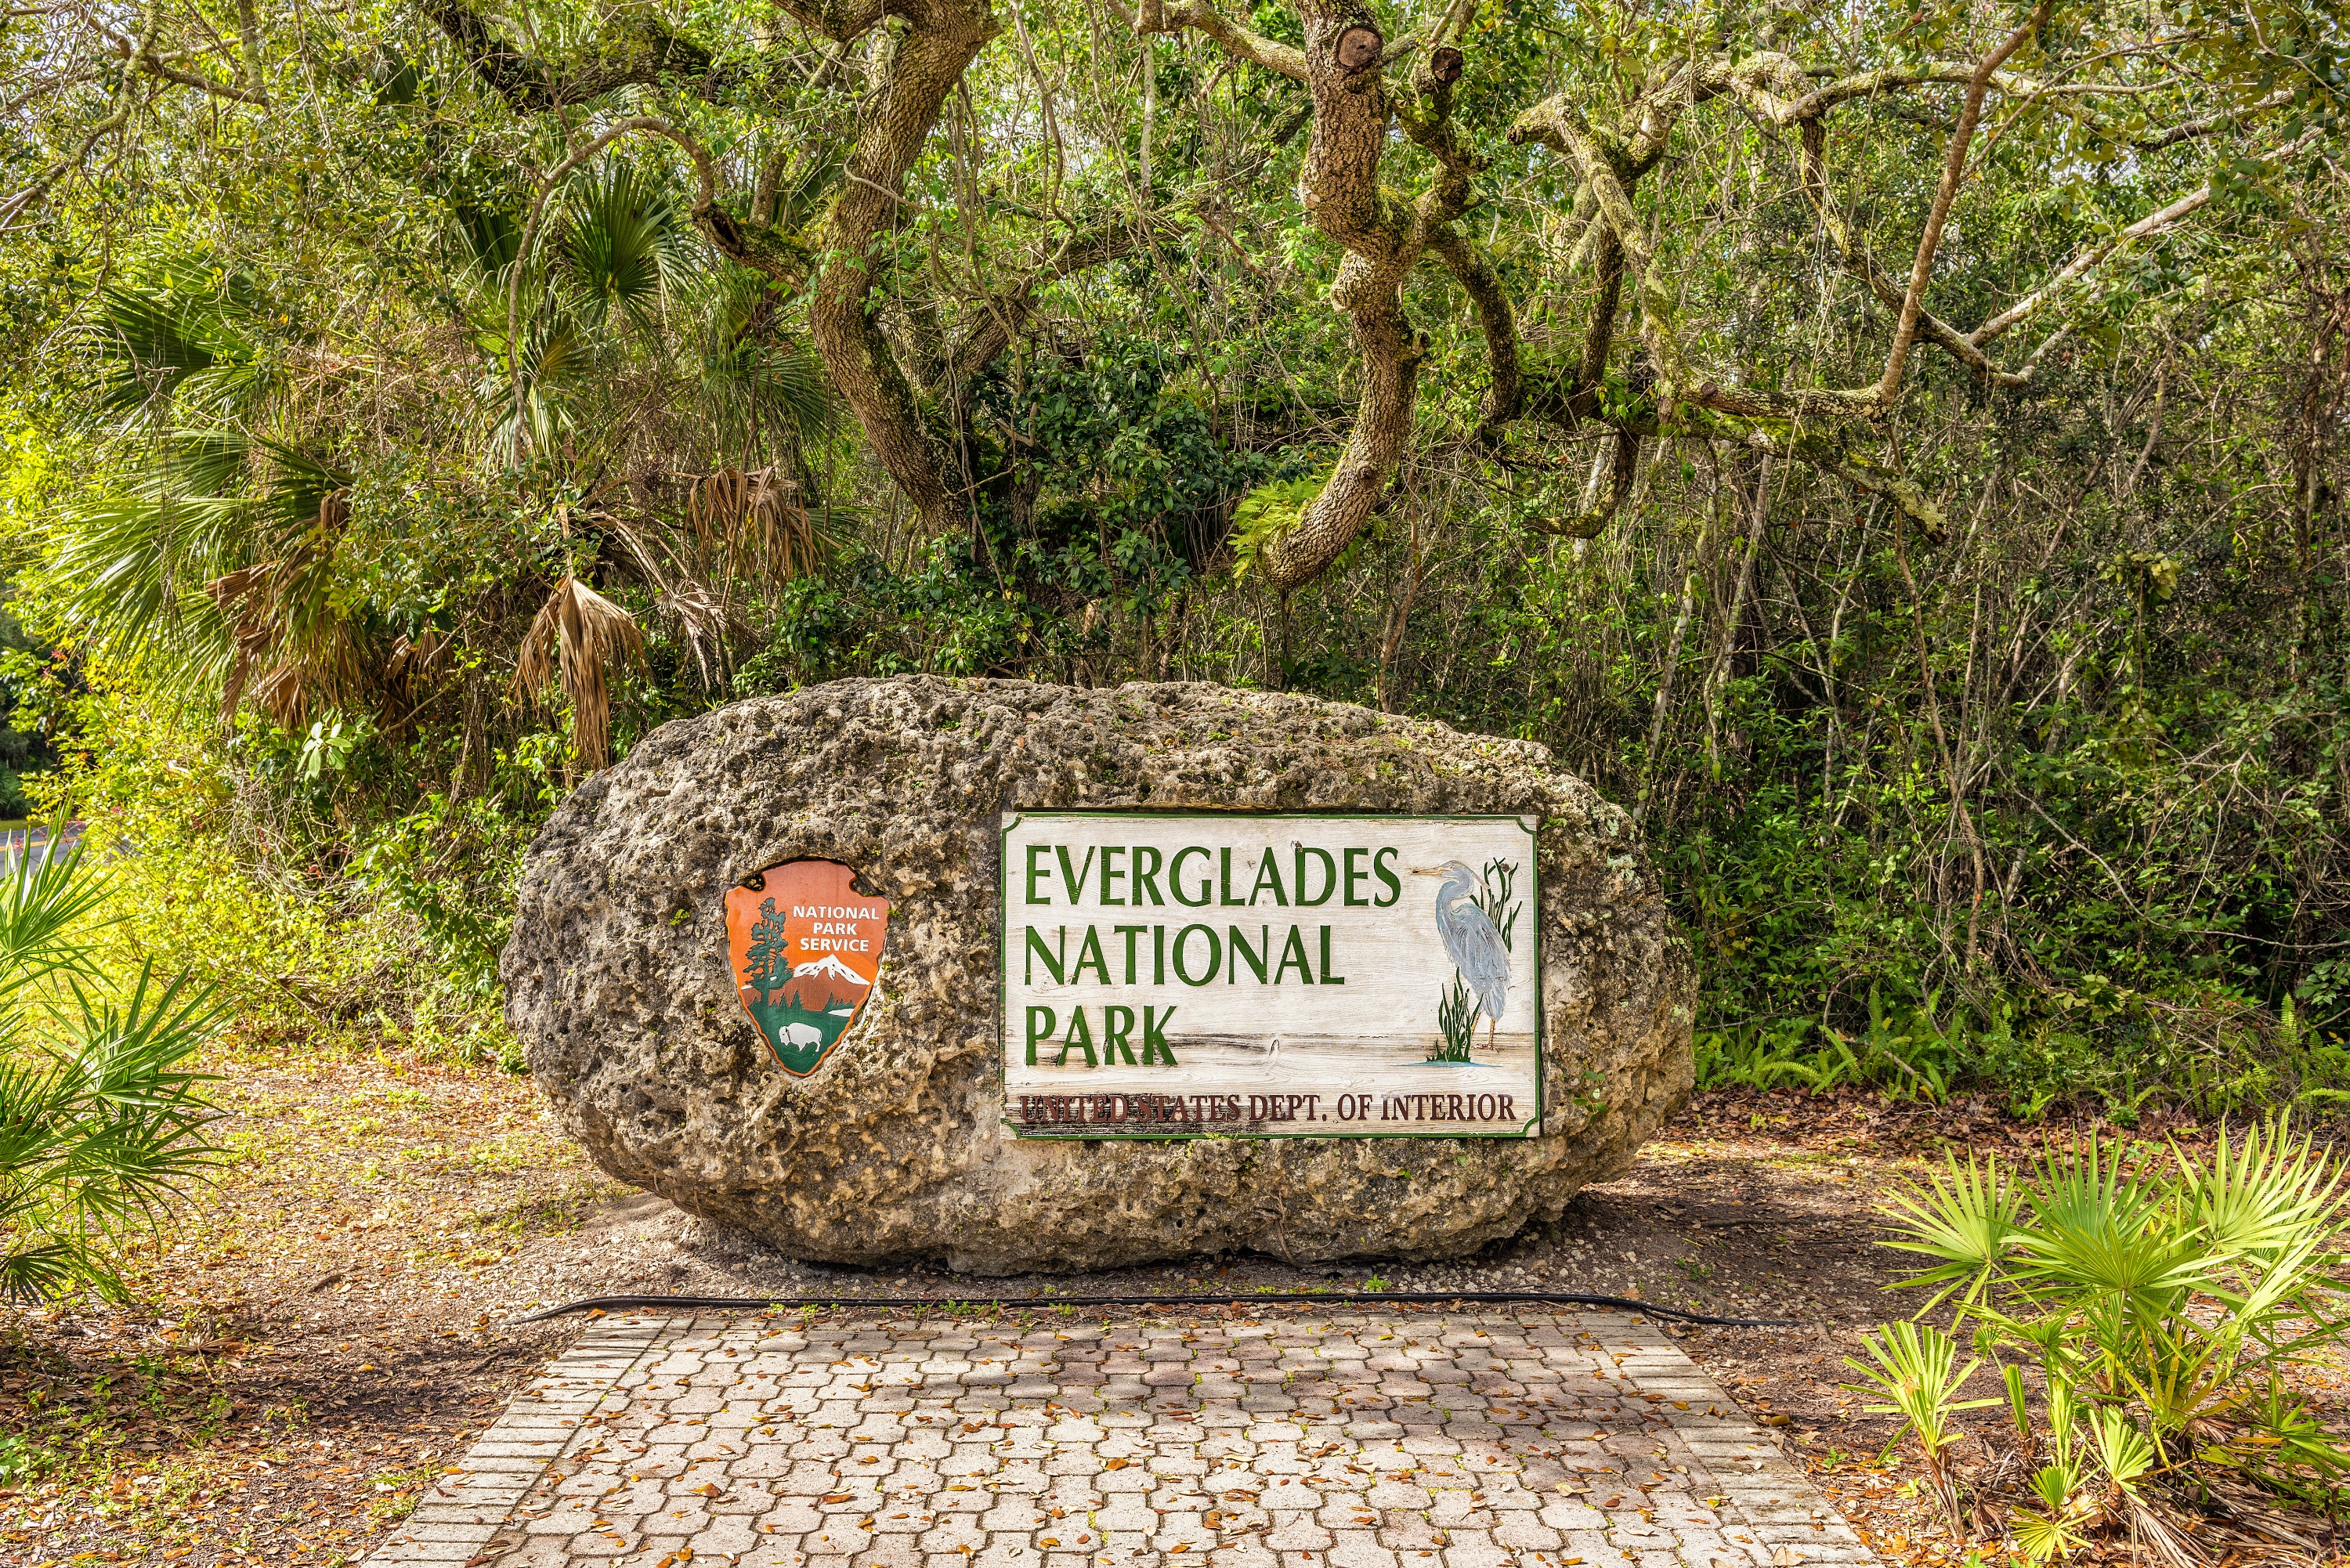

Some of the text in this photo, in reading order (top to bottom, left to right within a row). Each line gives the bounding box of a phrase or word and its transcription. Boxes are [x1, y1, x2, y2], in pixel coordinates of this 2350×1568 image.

[1025, 845, 1401, 907] EVERGLADES
[793, 905, 880, 919] NATIONAL
[813, 922, 858, 935] PARK
[800, 938, 869, 952] SERVICE
[1025, 924, 1346, 986] NATIONAL
[1025, 1005, 1177, 1067] PARK
[1020, 1093, 1517, 1122] UNITED STATES DEPT. OF INTERIOR
